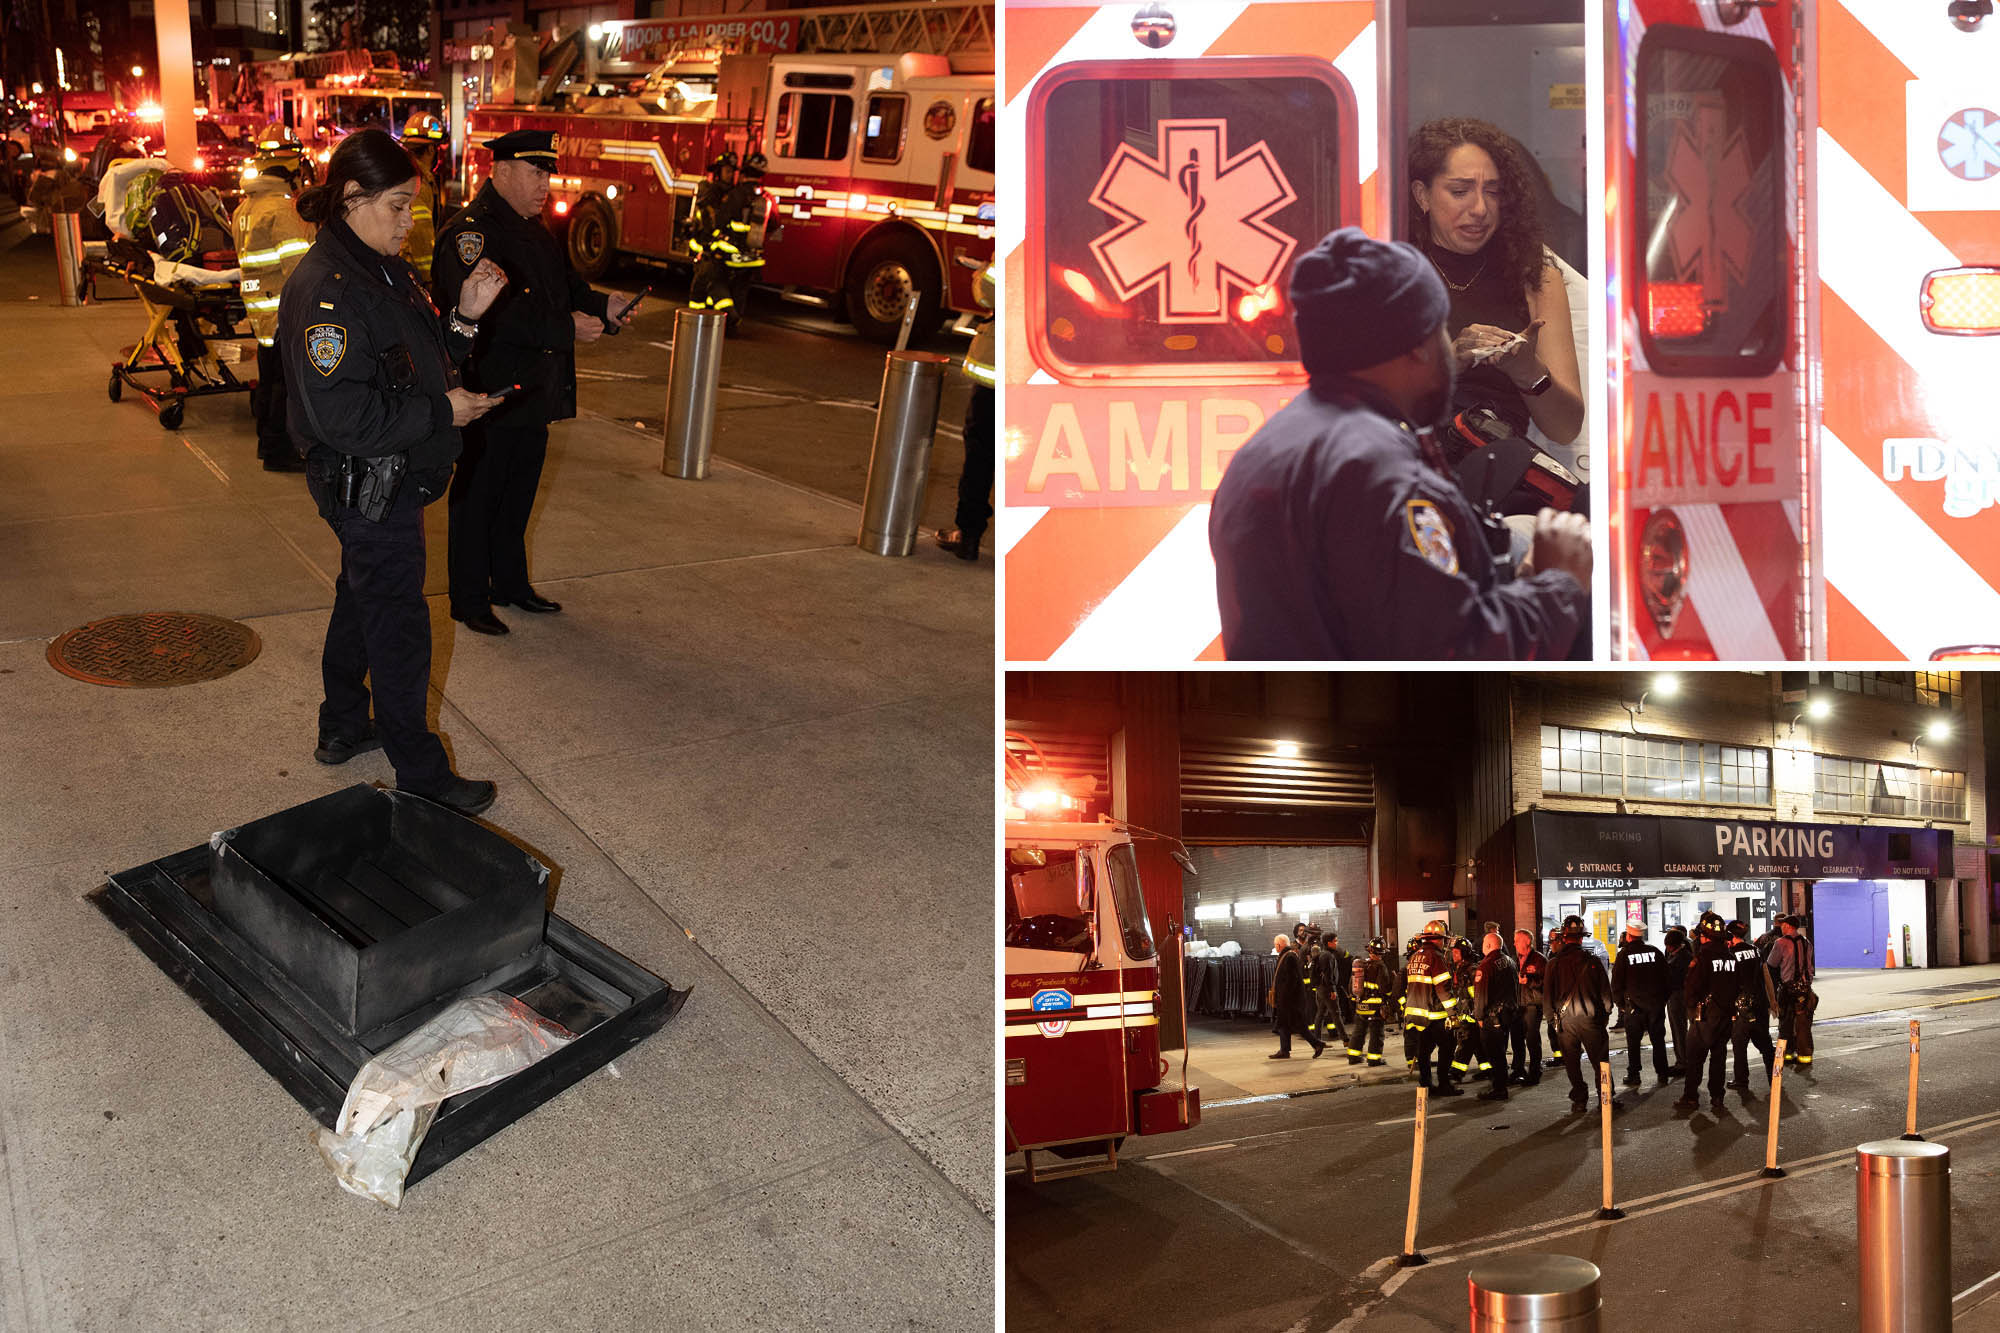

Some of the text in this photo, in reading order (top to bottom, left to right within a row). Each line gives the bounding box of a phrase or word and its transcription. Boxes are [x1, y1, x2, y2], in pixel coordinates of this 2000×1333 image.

[626, 27, 662, 54] HOOK
[667, 25, 675, 38] &
[1637, 389, 1776, 489] ANCE
[1715, 824, 1834, 858] PARKING
[1579, 863, 1622, 873] ENTRANCE
[1664, 864, 1706, 873] CLEARANCE
[1758, 865, 1790, 873] ENTRANCE
[1822, 866, 1853, 874] CLEARANCE
[1573, 879, 1624, 888] PULL AHEAD
[1730, 882, 1764, 891] EXIT ONLY
[1627, 952, 1656, 965] FDNY
